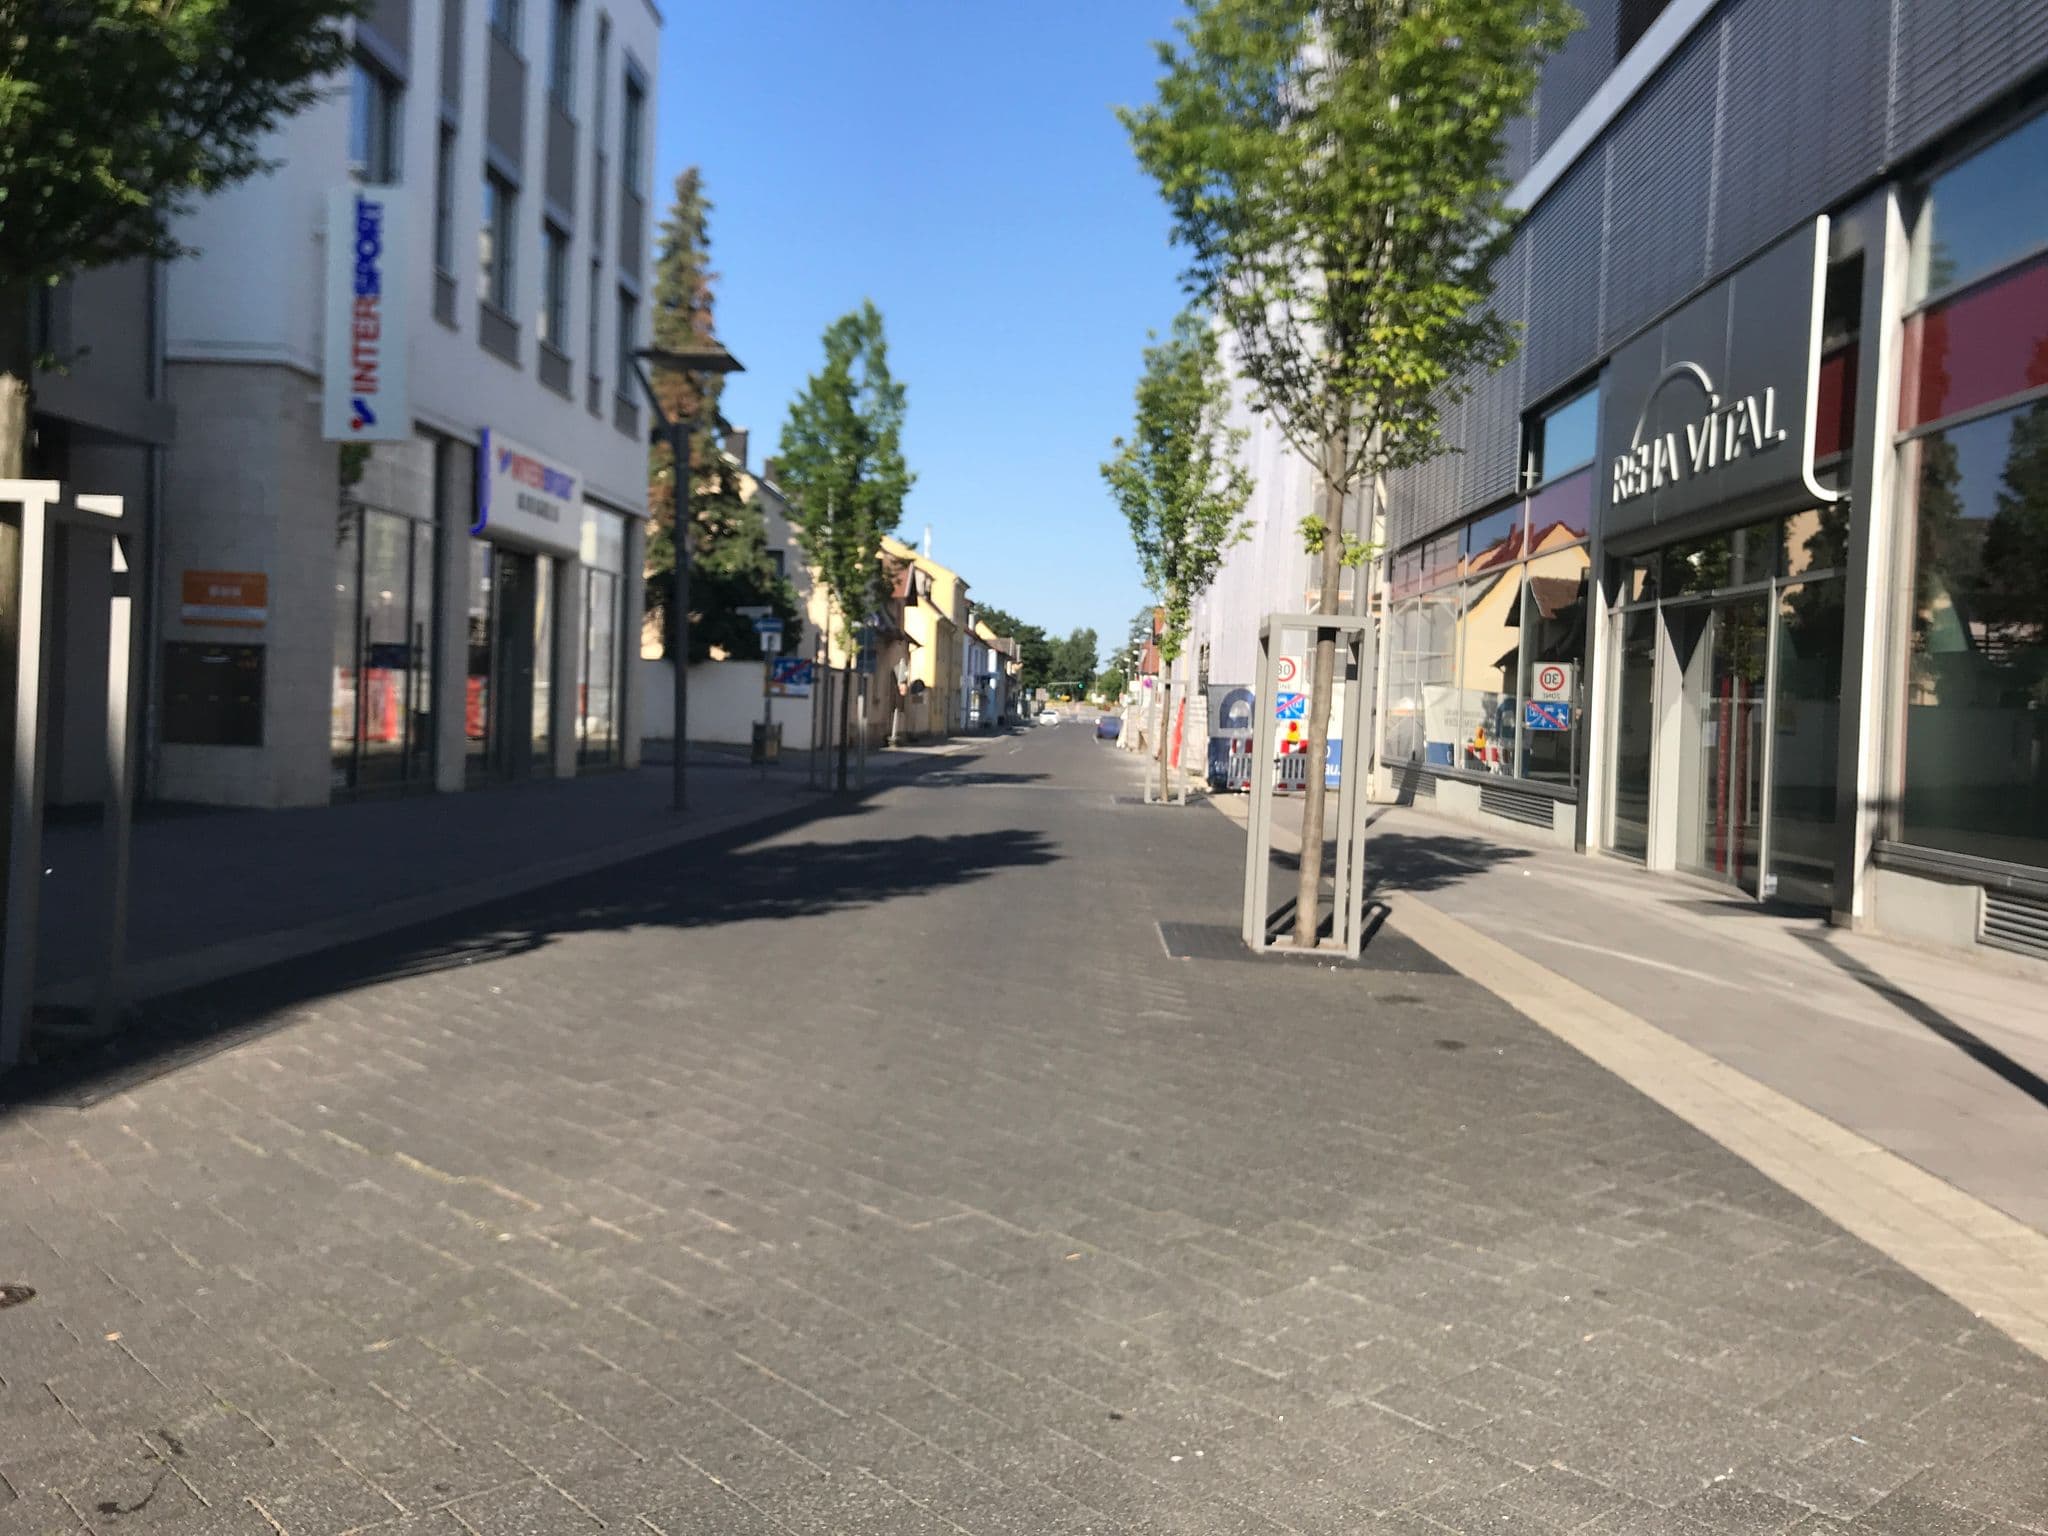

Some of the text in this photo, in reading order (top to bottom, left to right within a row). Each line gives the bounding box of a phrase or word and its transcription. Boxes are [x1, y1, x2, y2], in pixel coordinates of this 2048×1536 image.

[352, 194, 383, 394] INTERSPORT
[1612, 386, 1787, 504] REHA VITAL
